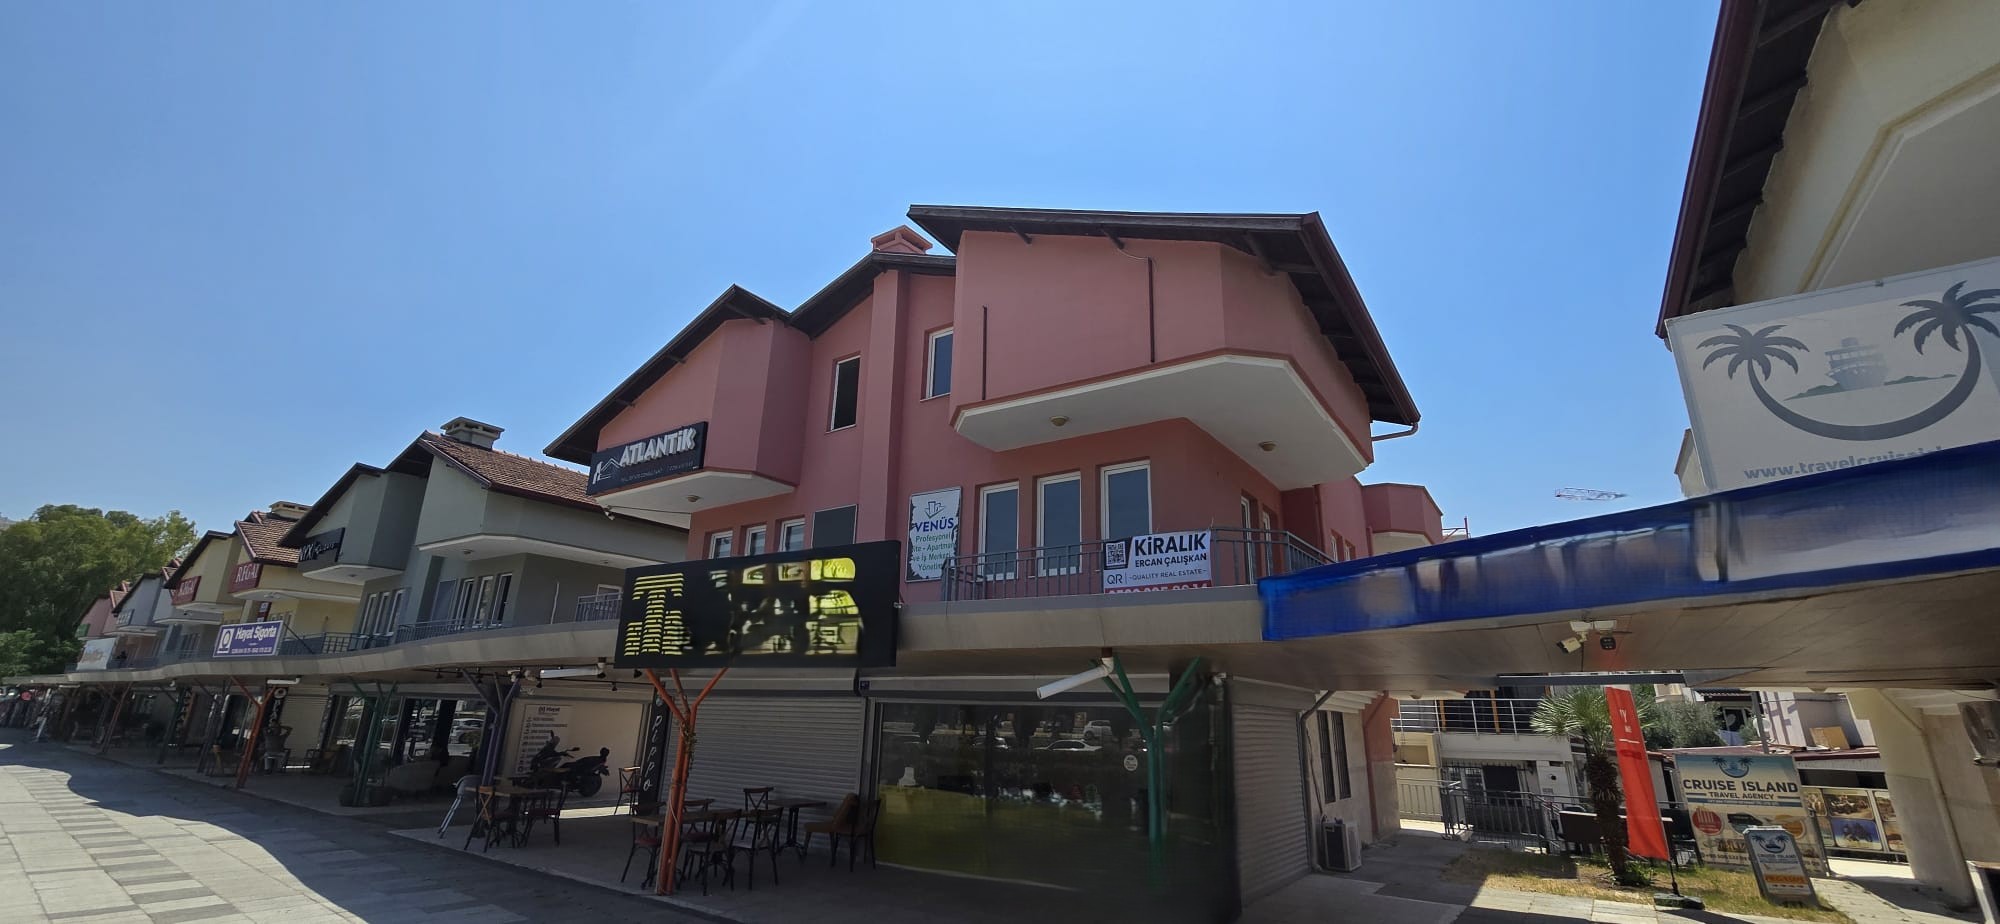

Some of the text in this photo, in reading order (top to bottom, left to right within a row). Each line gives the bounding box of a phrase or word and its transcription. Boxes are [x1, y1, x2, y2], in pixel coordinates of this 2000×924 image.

[915, 517, 954, 531] VENÜS
[1135, 553, 1206, 568] ERCAN ÇALIŞKAN
[1107, 574, 1123, 585] QR
[1683, 779, 1798, 792] CRUISE ISLAND
